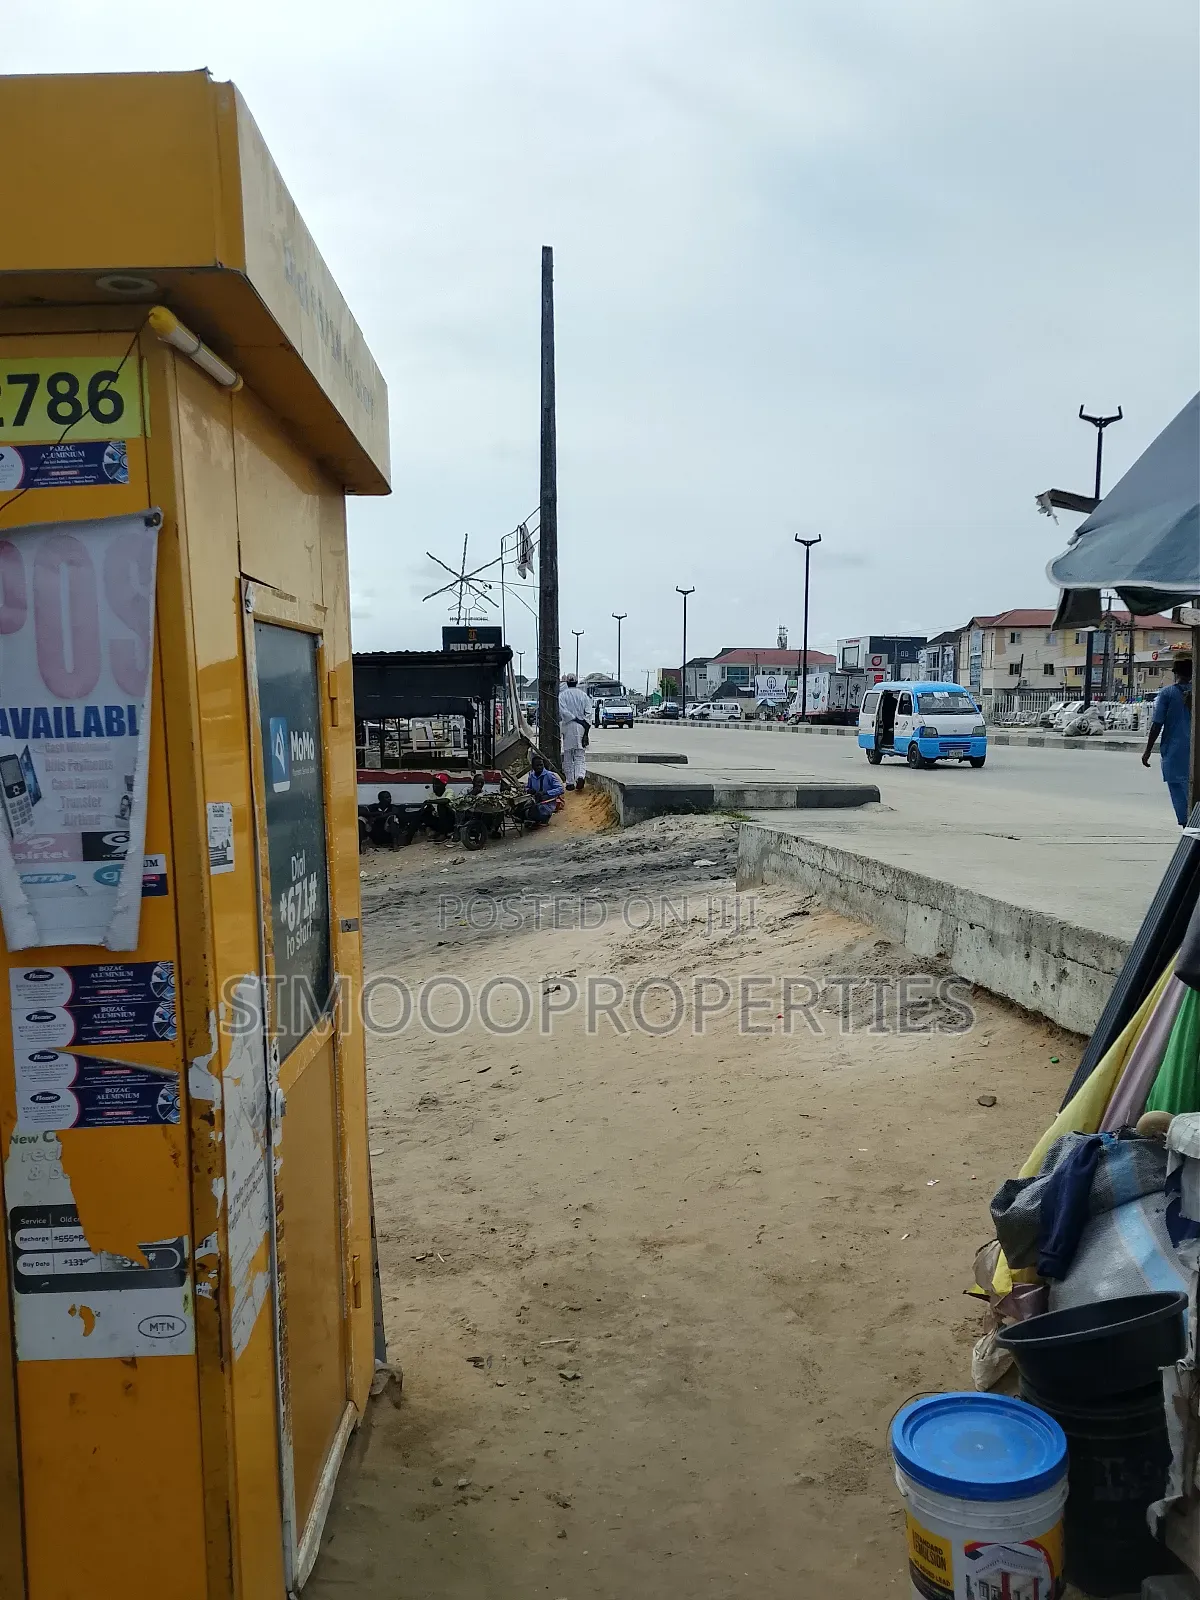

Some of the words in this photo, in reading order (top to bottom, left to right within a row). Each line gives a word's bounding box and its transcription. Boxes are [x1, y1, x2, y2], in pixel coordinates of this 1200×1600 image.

[0, 370, 124, 427] 786
[290, 731, 315, 762] MoMo
[60, 795, 102, 809] Transfer
[14, 850, 71, 860] airtel
[291, 849, 306, 882] Dial
[286, 933, 296, 960] to
[294, 919, 313, 951] start
[92, 1011, 136, 1019] ALUMINIUM
[96, 1092, 140, 1100] ALUMINIUM
[9, 1134, 39, 1145] New
[149, 1322, 175, 1333] MTN
[915, 1532, 943, 1555] STANDARD
[915, 1540, 946, 1572] EMULSION
